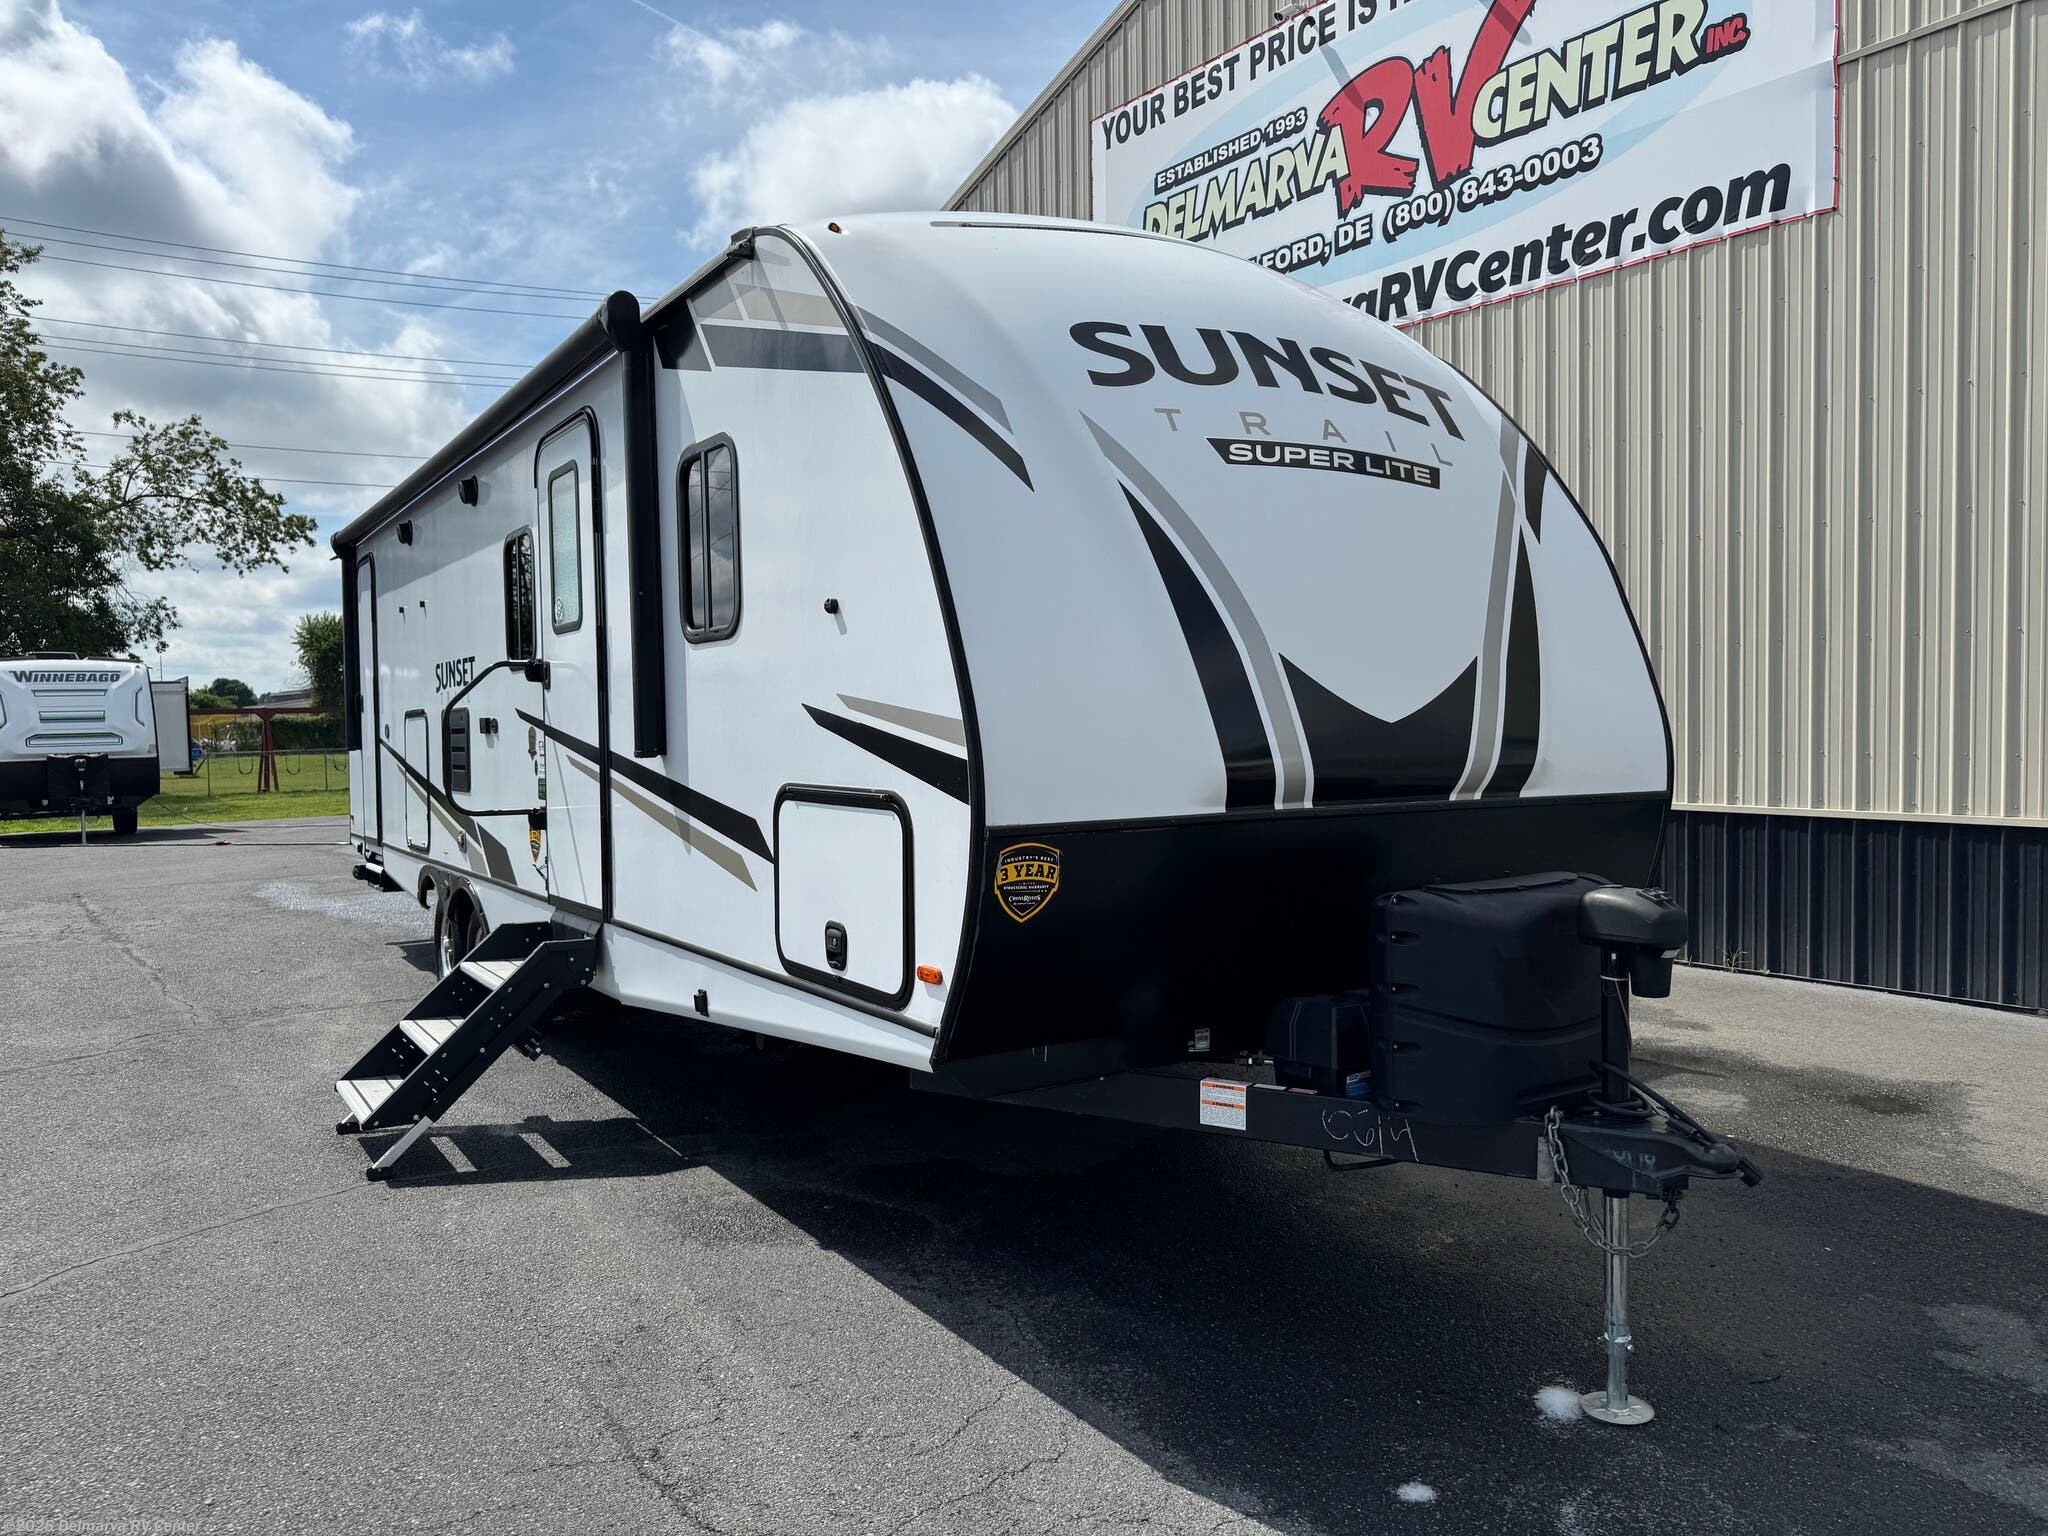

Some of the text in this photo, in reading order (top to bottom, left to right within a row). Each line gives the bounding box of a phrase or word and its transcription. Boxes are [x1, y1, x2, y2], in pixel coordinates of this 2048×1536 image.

[1101, 0, 1377, 151] YOUR BEST PRICE IS
[1144, 0, 1748, 241] DELMARVA RV CENTER INC.
[1156, 108, 1308, 190] ESTABLISHED 1993
[1249, 136, 1600, 270] FORD, DE (800) 843-0003
[1342, 163, 1791, 322] aRVCenter.com
[1069, 320, 1466, 442] SUNSET
[1153, 407, 1454, 467] TRAIL
[1228, 443, 1432, 485] SUPER LITE
[9, 670, 122, 683] WINNEBAGO
[435, 655, 476, 694] SUNSET
[1000, 863, 1057, 882] 3 YEAR
